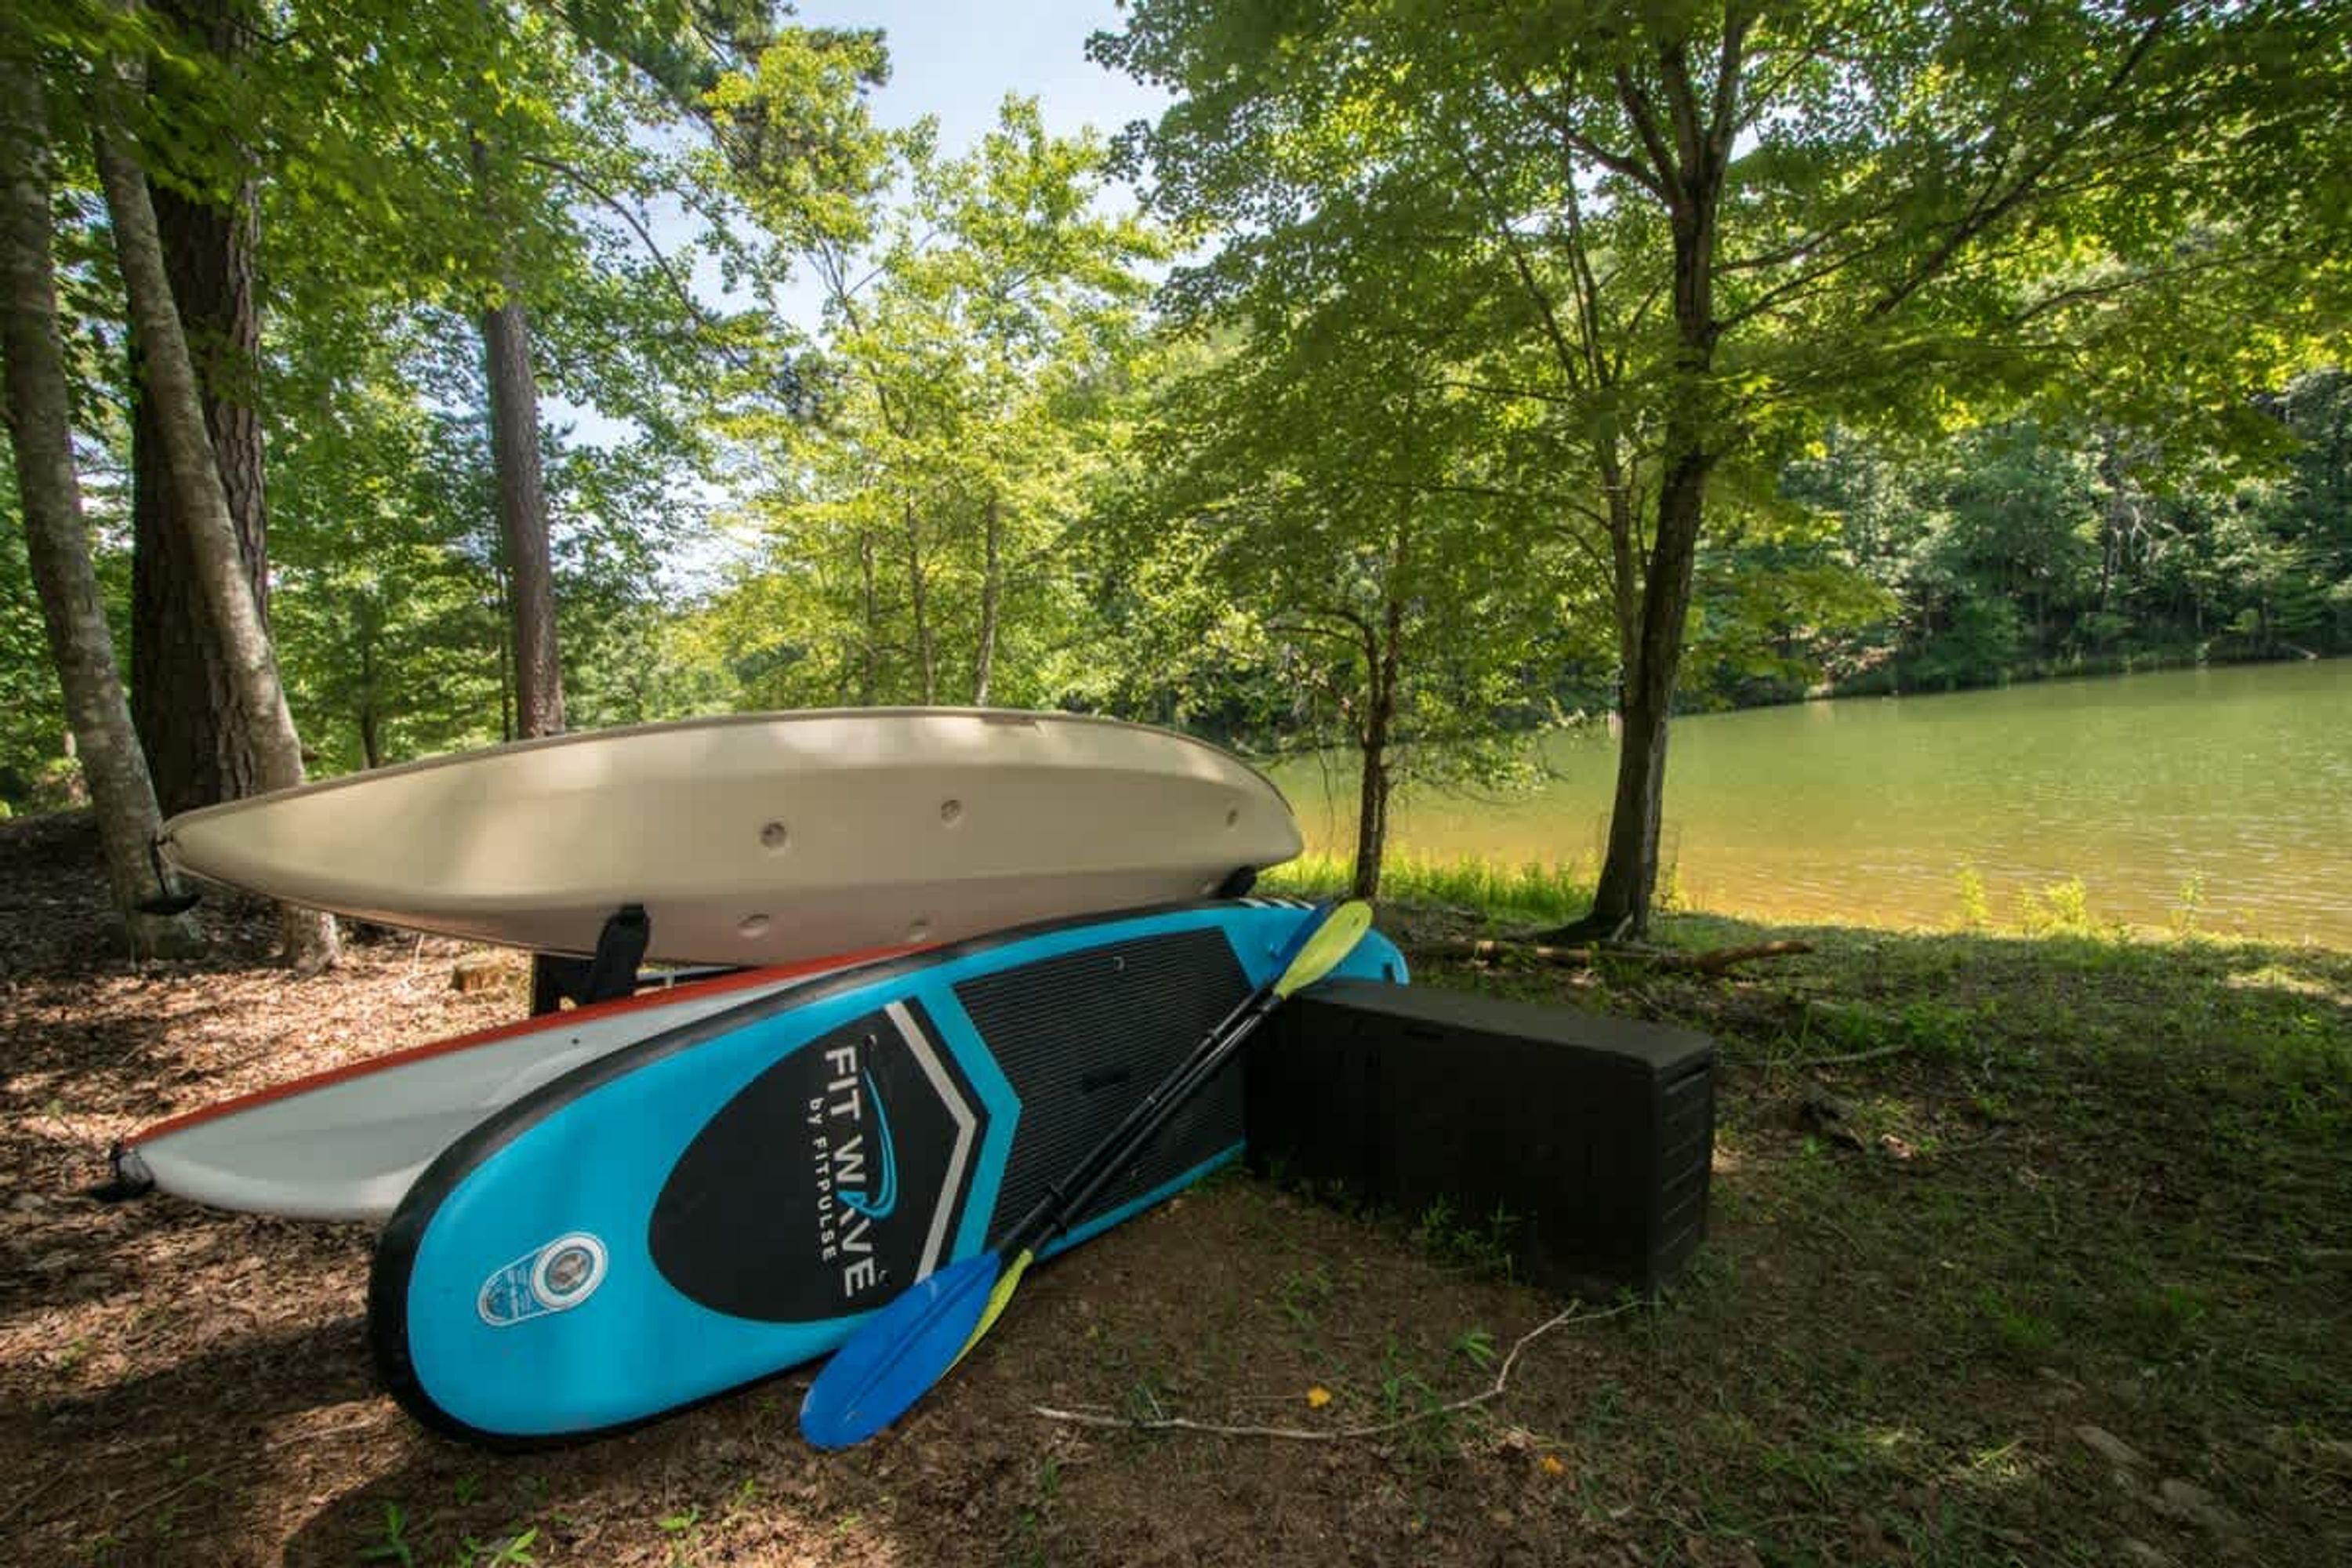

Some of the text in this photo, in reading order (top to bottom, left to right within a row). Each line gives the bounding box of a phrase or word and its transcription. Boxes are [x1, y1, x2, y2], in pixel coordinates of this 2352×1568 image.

[813, 1137, 837, 1260] FITPULSE
[826, 1047, 875, 1297] FIT WAVE
